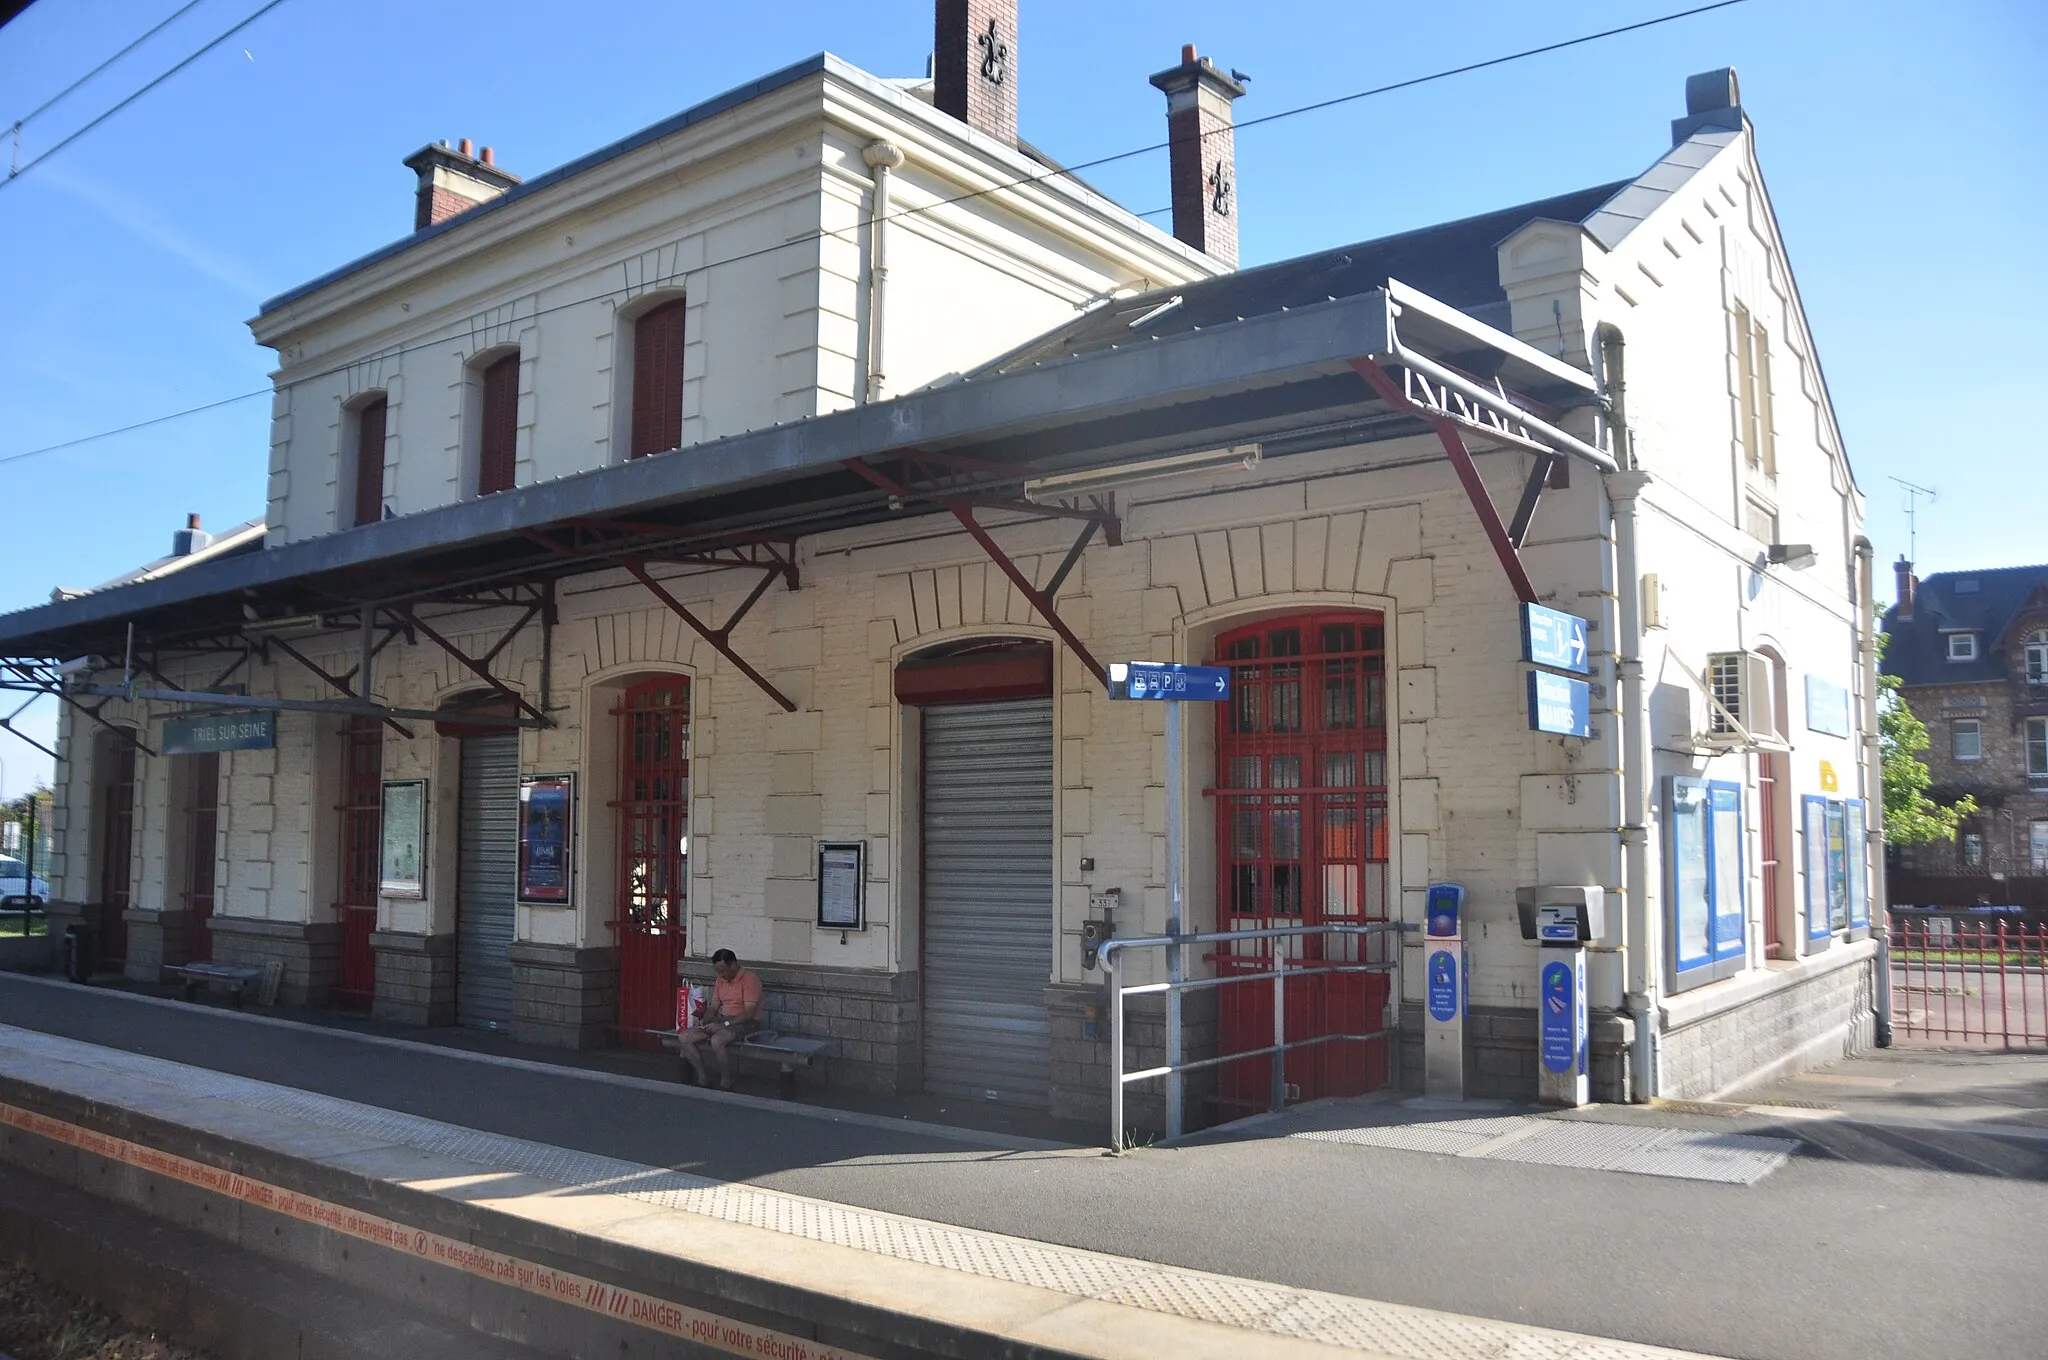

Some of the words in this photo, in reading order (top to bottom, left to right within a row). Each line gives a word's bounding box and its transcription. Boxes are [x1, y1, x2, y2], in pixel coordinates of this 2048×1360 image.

[192, 727, 216, 742] TRIEL
[219, 724, 237, 740] SUR
[239, 721, 267, 738] SEINE
[244, 1182, 274, 1205] DANGER
[279, 1195, 295, 1212] pour
[296, 1199, 313, 1217] votre
[313, 1203, 342, 1227] sécurité
[347, 1215, 357, 1230] ne
[358, 1216, 393, 1241] traversez
[393, 1229, 408, 1247] pas
[434, 1241, 445, 1257] ne
[447, 1242, 495, 1274] descendez
[497, 1260, 515, 1279] pas
[517, 1267, 534, 1284] sur
[536, 1267, 551, 1289] les
[552, 1276, 581, 1299] voies
[632, 1298, 682, 1331] DANGER
[691, 1318, 719, 1340] pour
[722, 1326, 752, 1350] votre
[756, 1332, 806, 1360] sécurité
